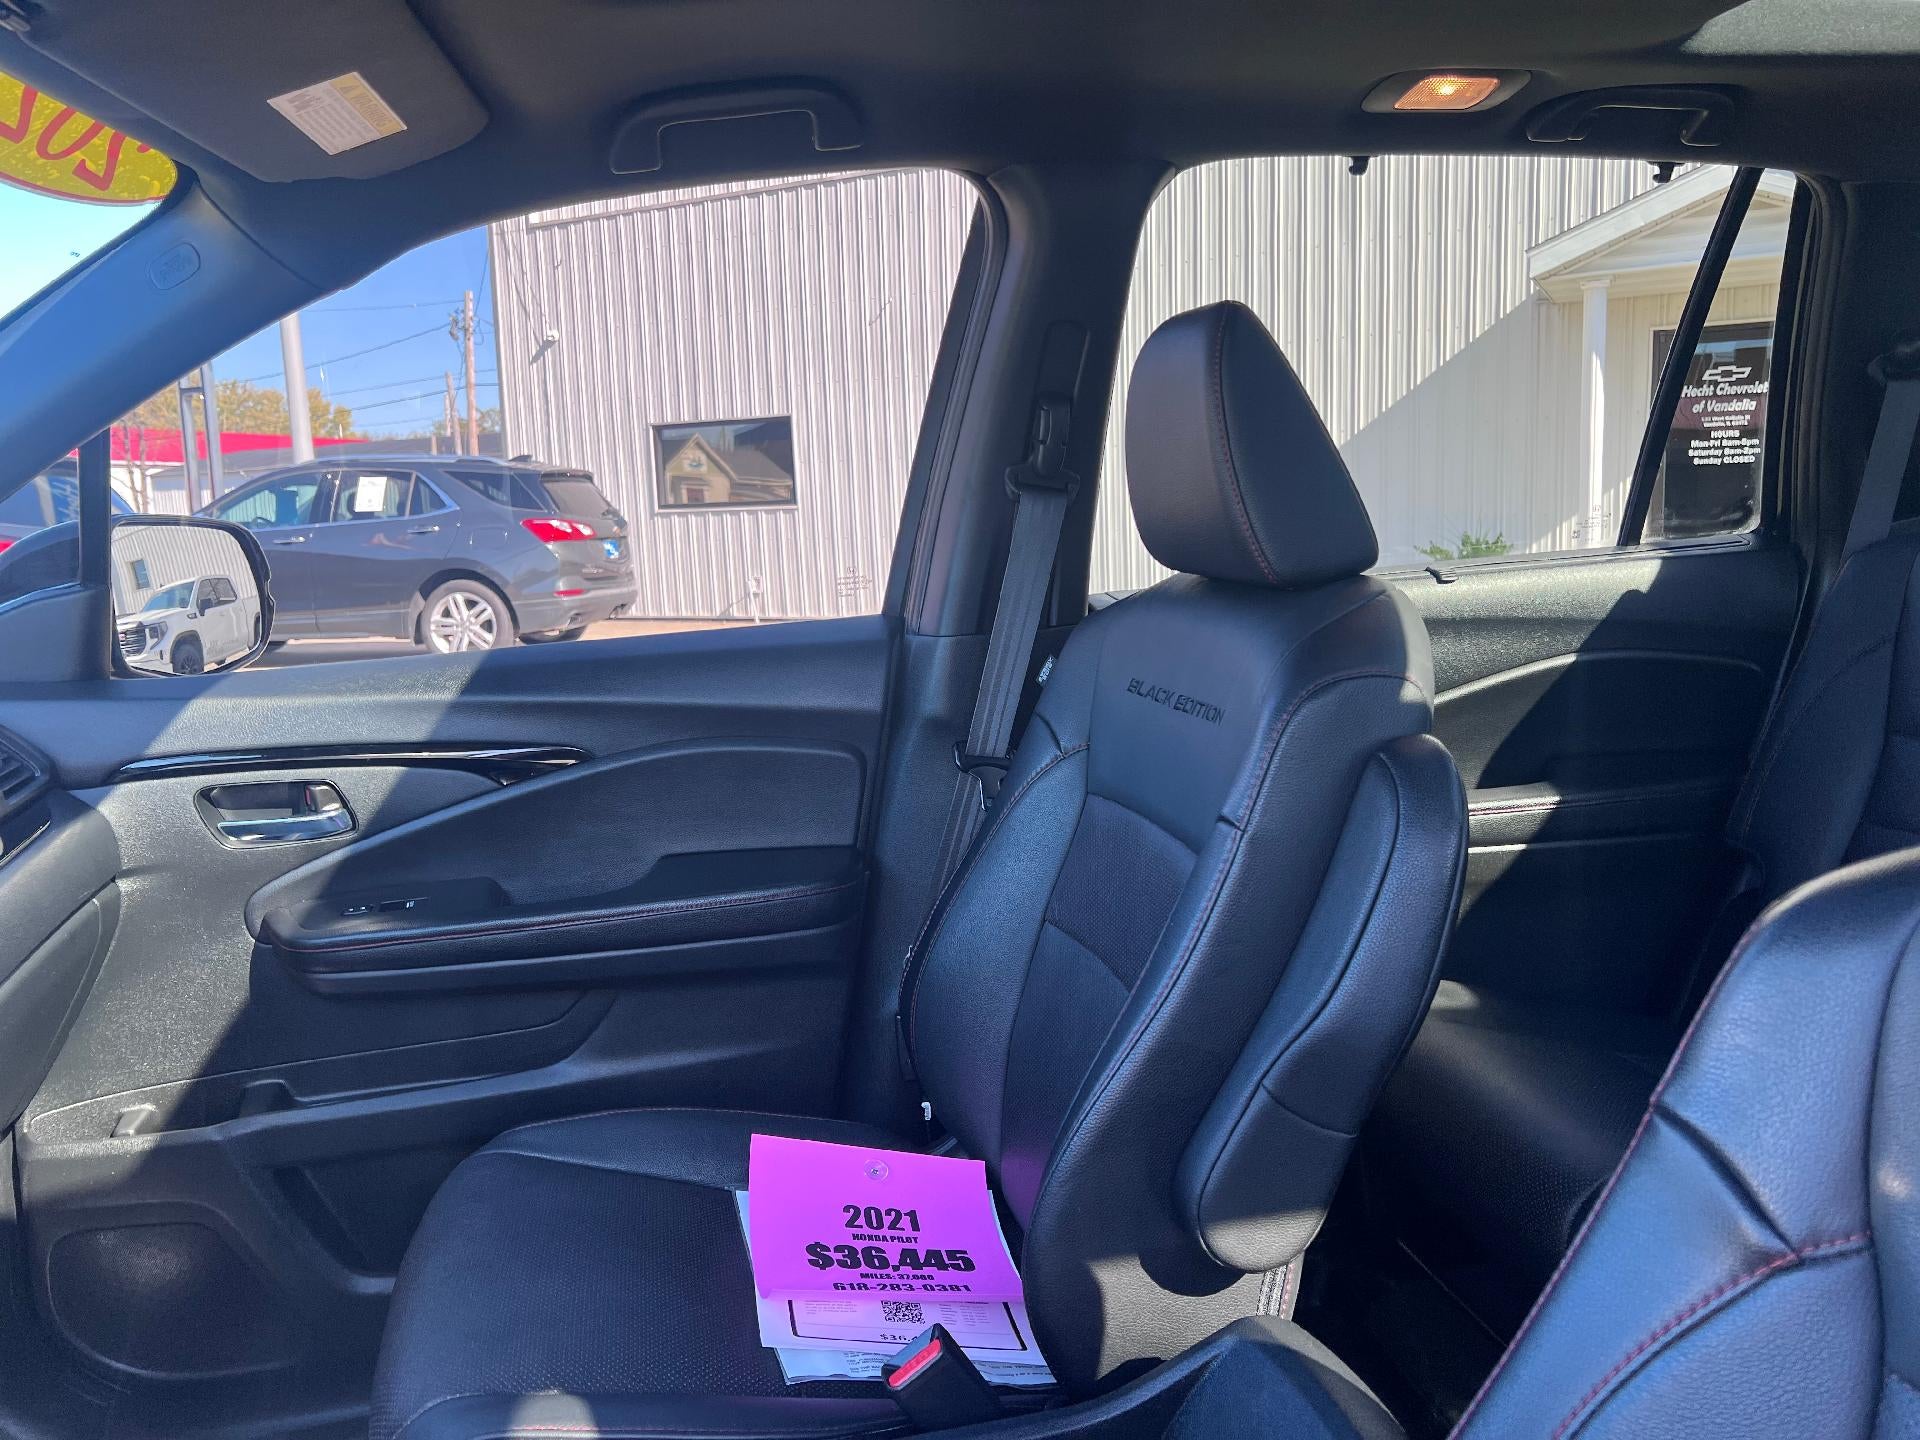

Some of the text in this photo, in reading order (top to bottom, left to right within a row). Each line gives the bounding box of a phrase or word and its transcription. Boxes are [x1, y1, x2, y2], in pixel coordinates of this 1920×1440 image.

[1681, 381, 1769, 397] Hecht Chevrolet
[1692, 399, 1757, 413] of Vandalia
[1711, 430, 1740, 438] HOURS
[1688, 448, 1722, 456] Saturday
[1693, 455, 1756, 465] Sunday CLOSED
[1127, 677, 1226, 726] BLACK EDITION
[843, 1205, 921, 1232] 2021
[852, 1233, 919, 1244] HONDA PILOT
[805, 1242, 976, 1273] $36,445
[859, 1272, 896, 1280] MILES:
[832, 1282, 972, 1292] 618-283-0381
